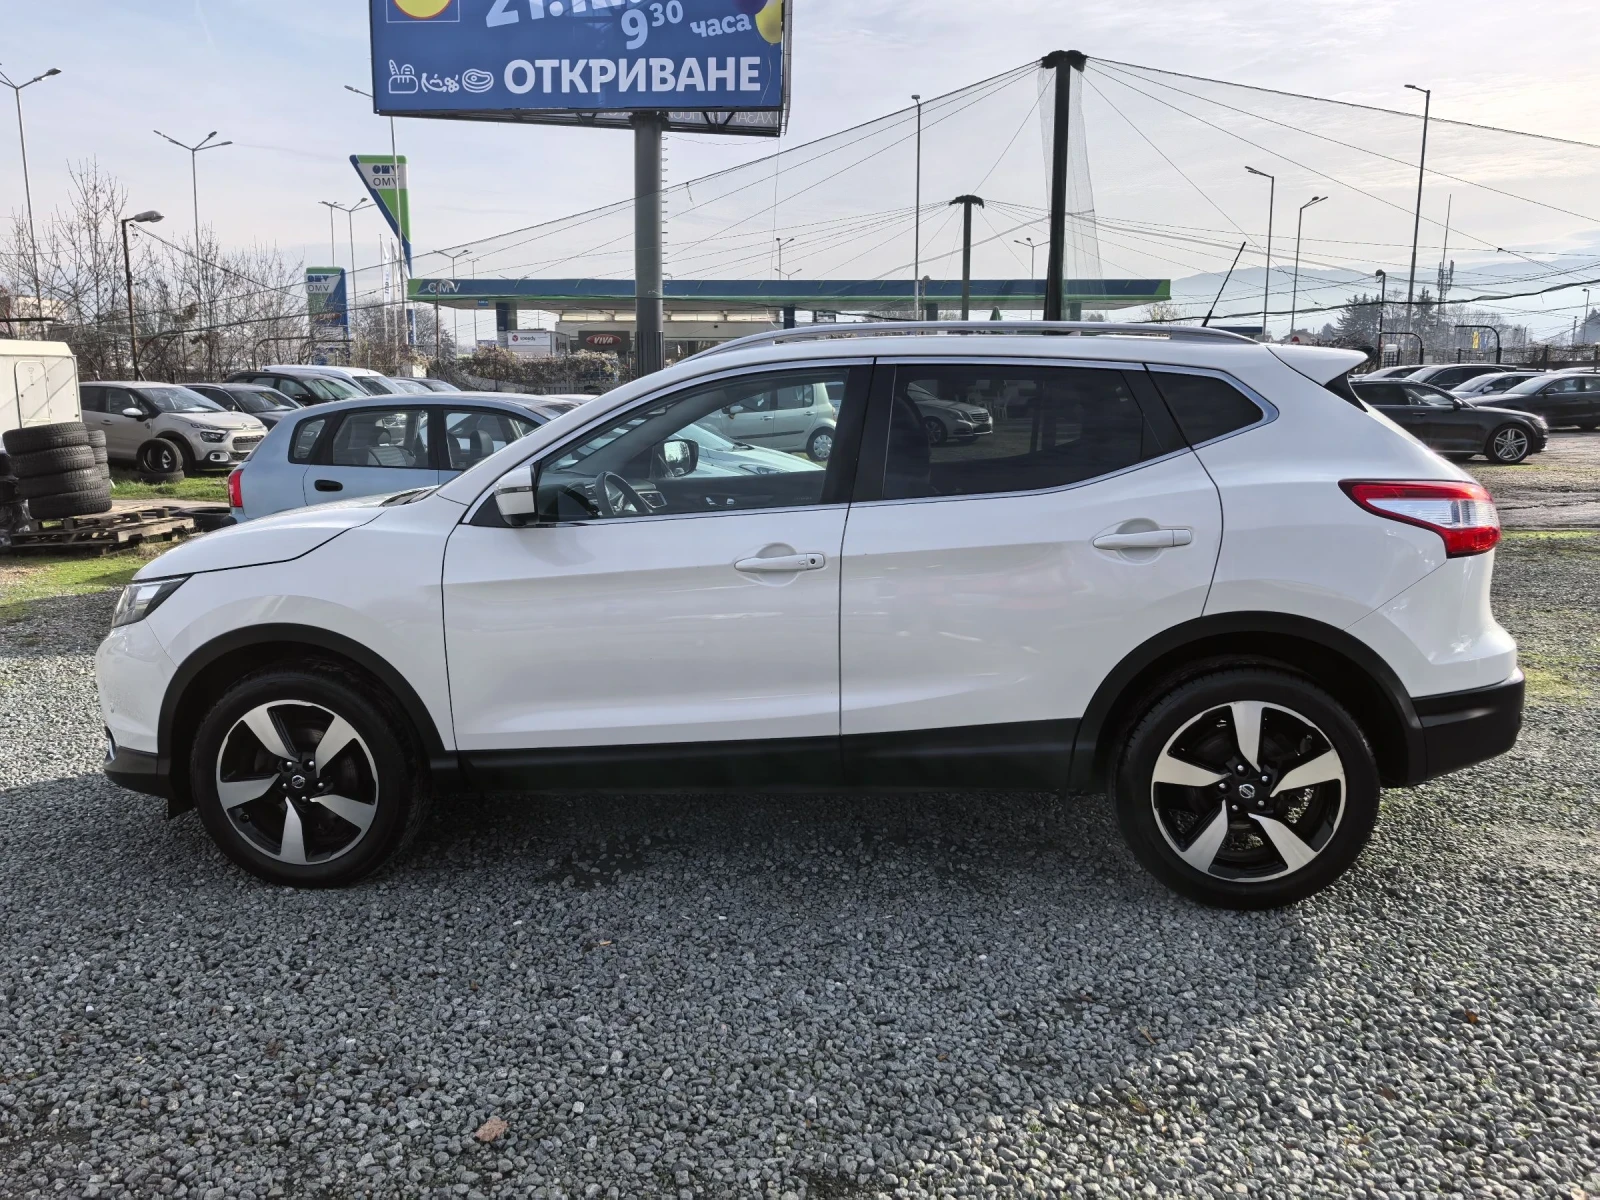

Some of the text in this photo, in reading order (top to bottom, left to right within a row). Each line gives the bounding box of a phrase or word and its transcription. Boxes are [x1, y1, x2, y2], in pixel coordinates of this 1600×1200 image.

[690, 13, 752, 38] часа
[503, 56, 761, 94] ОТКРИВАНЕ
[307, 284, 330, 292] OMV
[428, 281, 460, 293] OMV
[593, 336, 613, 345] VIVA
